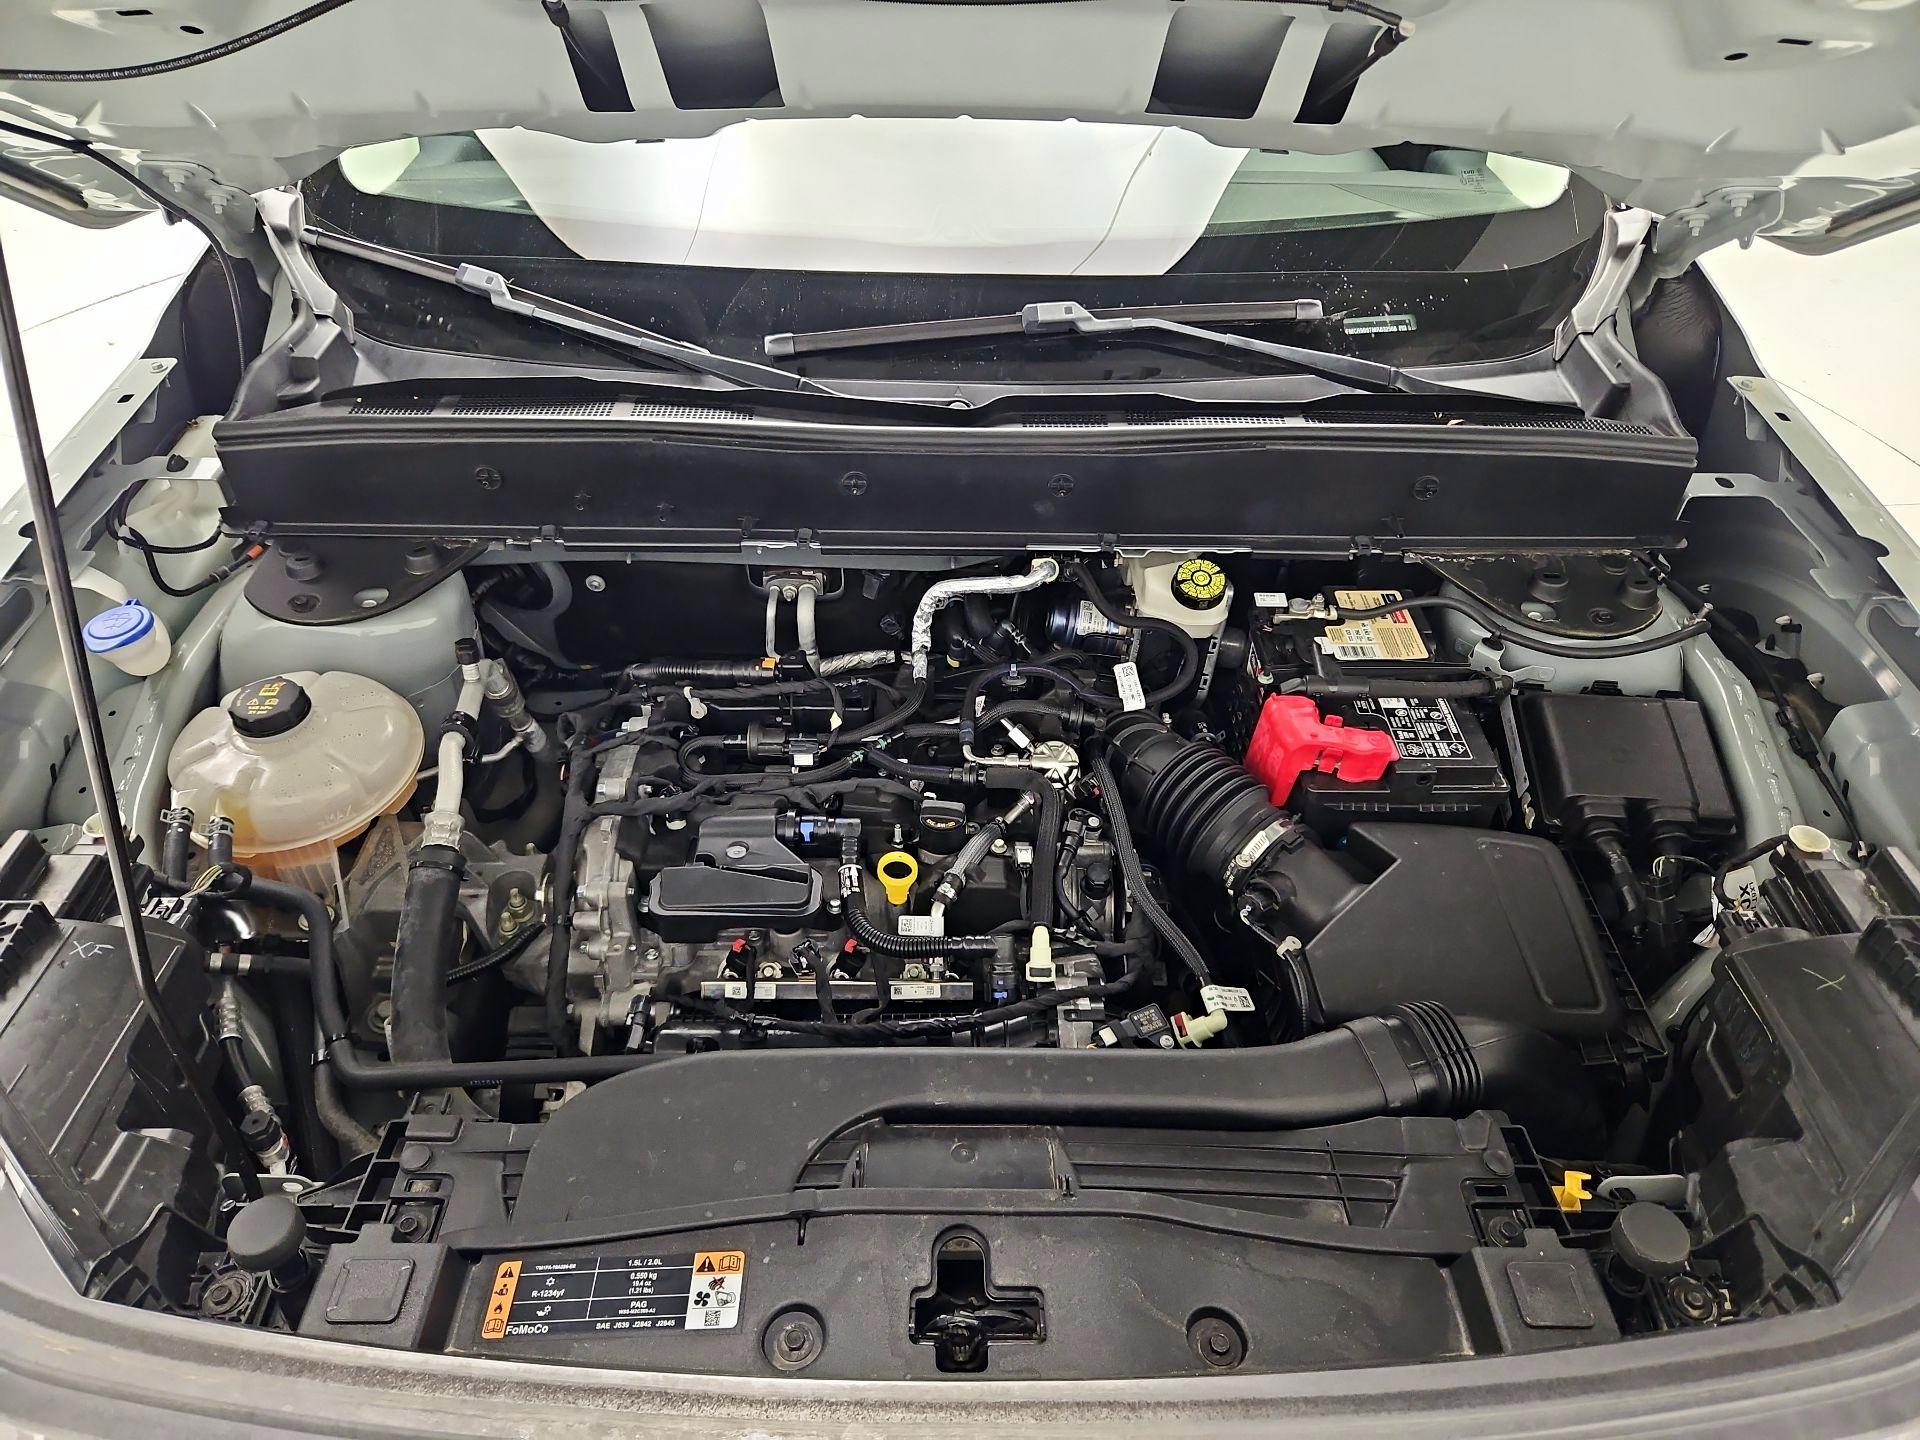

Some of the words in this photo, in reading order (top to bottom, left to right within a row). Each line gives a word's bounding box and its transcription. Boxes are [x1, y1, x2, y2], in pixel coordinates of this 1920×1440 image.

[627, 1259, 642, 1267] 1.5L
[647, 1258, 663, 1266] 2.0L
[648, 1271, 658, 1280] kg
[531, 1288, 565, 1299] R-1234yf
[630, 1300, 648, 1309] PAG
[505, 1323, 549, 1335] FoMoCo
[595, 1322, 611, 1330] SAE
[613, 1321, 630, 1329] J639
